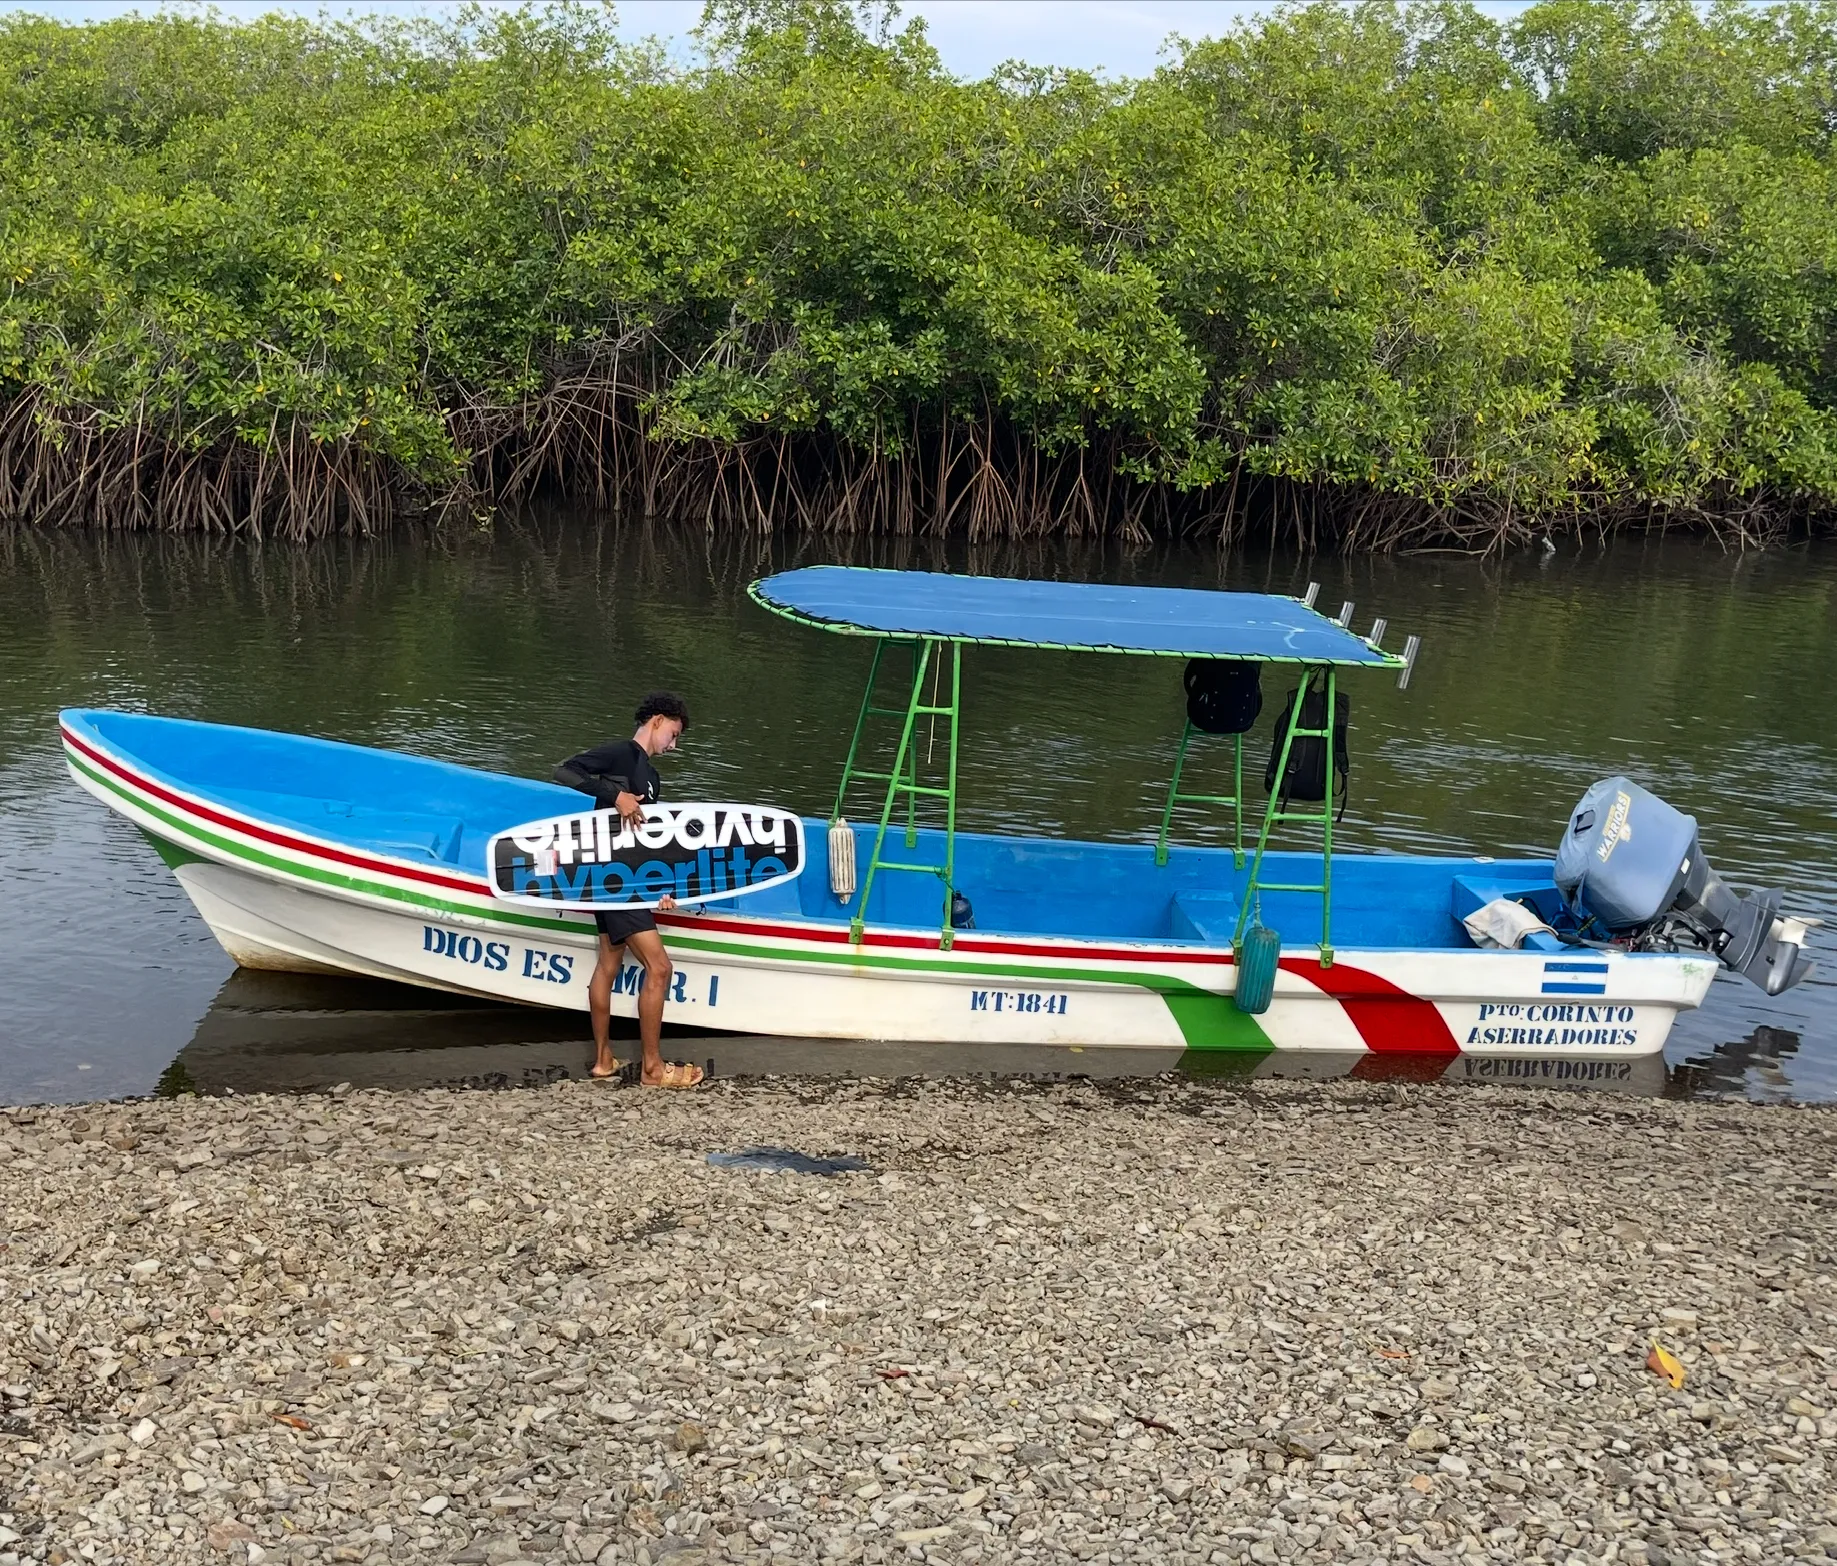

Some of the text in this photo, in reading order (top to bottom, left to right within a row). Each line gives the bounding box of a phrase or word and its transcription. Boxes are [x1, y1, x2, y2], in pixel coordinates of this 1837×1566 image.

[1597, 795, 1628, 858] WARRIORS
[423, 926, 510, 971] DIOS
[522, 948, 574, 984] ES
[587, 963, 696, 1003] MR.
[970, 990, 1068, 1014] MT:1841
[1466, 1027, 1638, 1046] ASERRADORES
